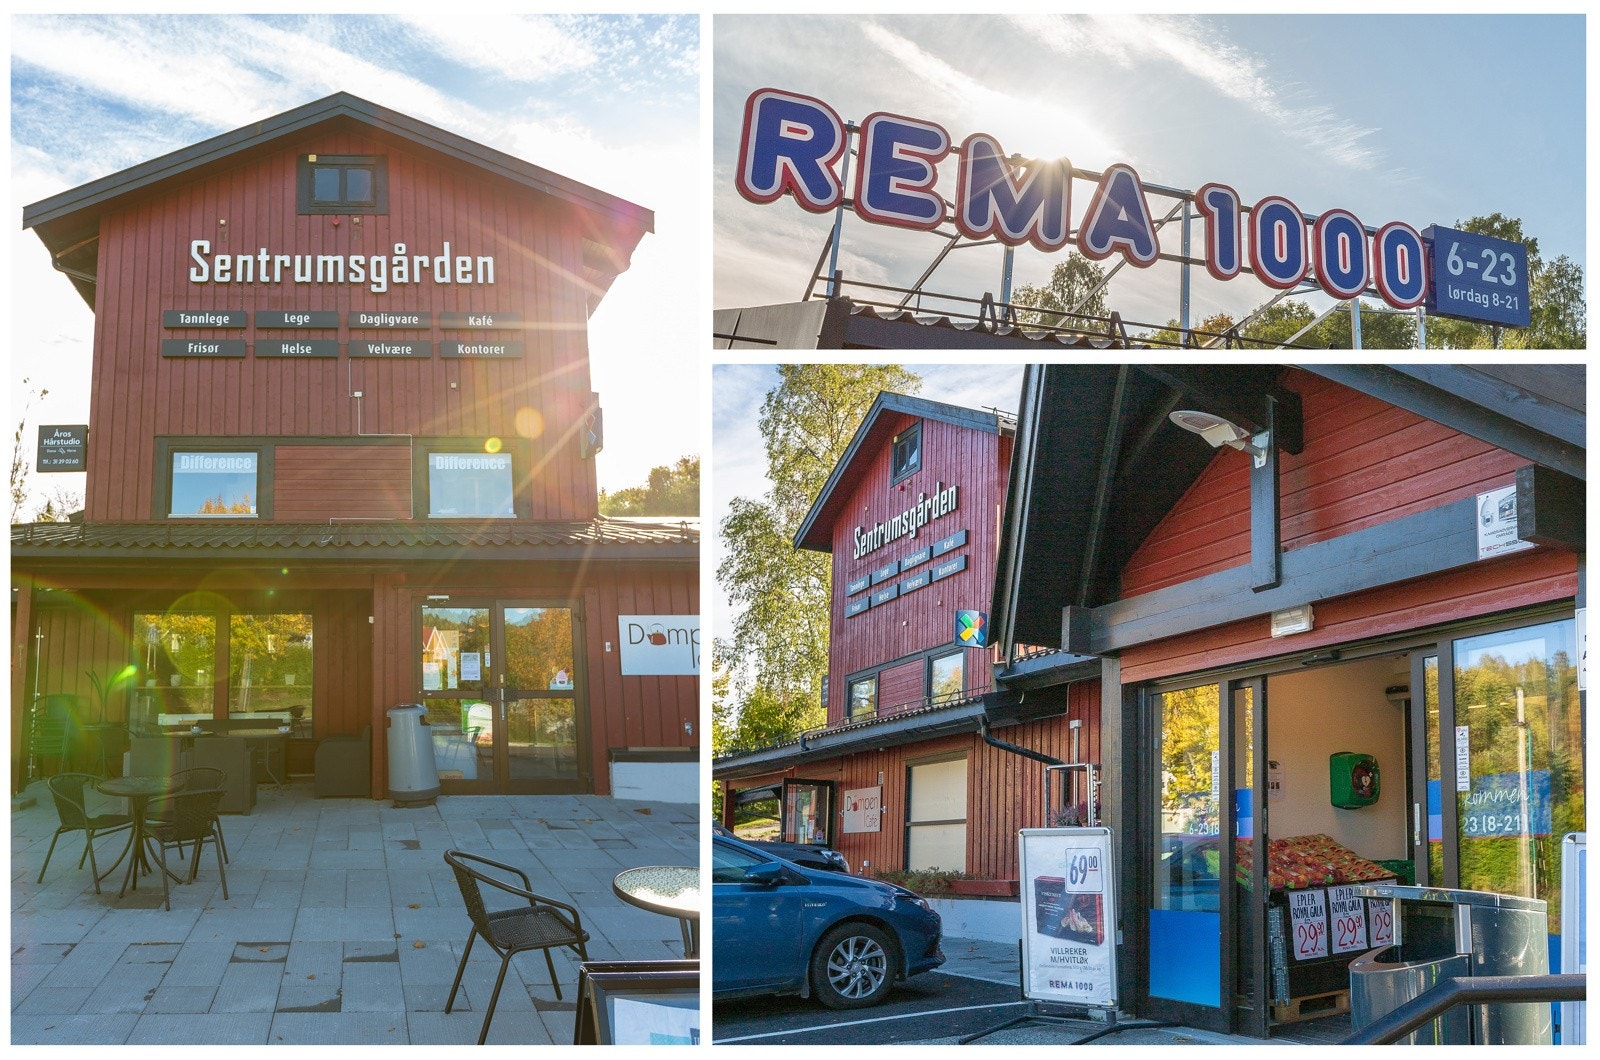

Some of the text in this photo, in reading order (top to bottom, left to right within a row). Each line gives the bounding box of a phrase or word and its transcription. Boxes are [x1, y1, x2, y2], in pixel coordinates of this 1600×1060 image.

[734, 87, 1430, 310] REMA 1000
[189, 239, 496, 293] Sentrumsgården
[1446, 241, 1517, 286] 6-23
[1448, 284, 1519, 310] lørdag 8-21
[179, 313, 230, 326] Tannlege
[284, 312, 310, 326] Lege
[360, 313, 419, 326] Dagligvare
[468, 314, 493, 326] Kafé
[187, 341, 219, 354] Frisør
[281, 342, 312, 354] Helse
[367, 343, 412, 355] Velvære
[457, 343, 505, 355] Kontorer
[53, 428, 71, 437] Åros
[180, 455, 252, 470] Difference
[435, 455, 506, 470] Difference
[853, 482, 957, 560] Sentrumsgården
[1296, 893, 1316, 907] EPLER
[1348, 899, 1362, 913] GALA
[1309, 905, 1324, 918] GALA
[1050, 946, 1087, 956] VILLREKER
[1049, 980, 1093, 991] REMA 1000
